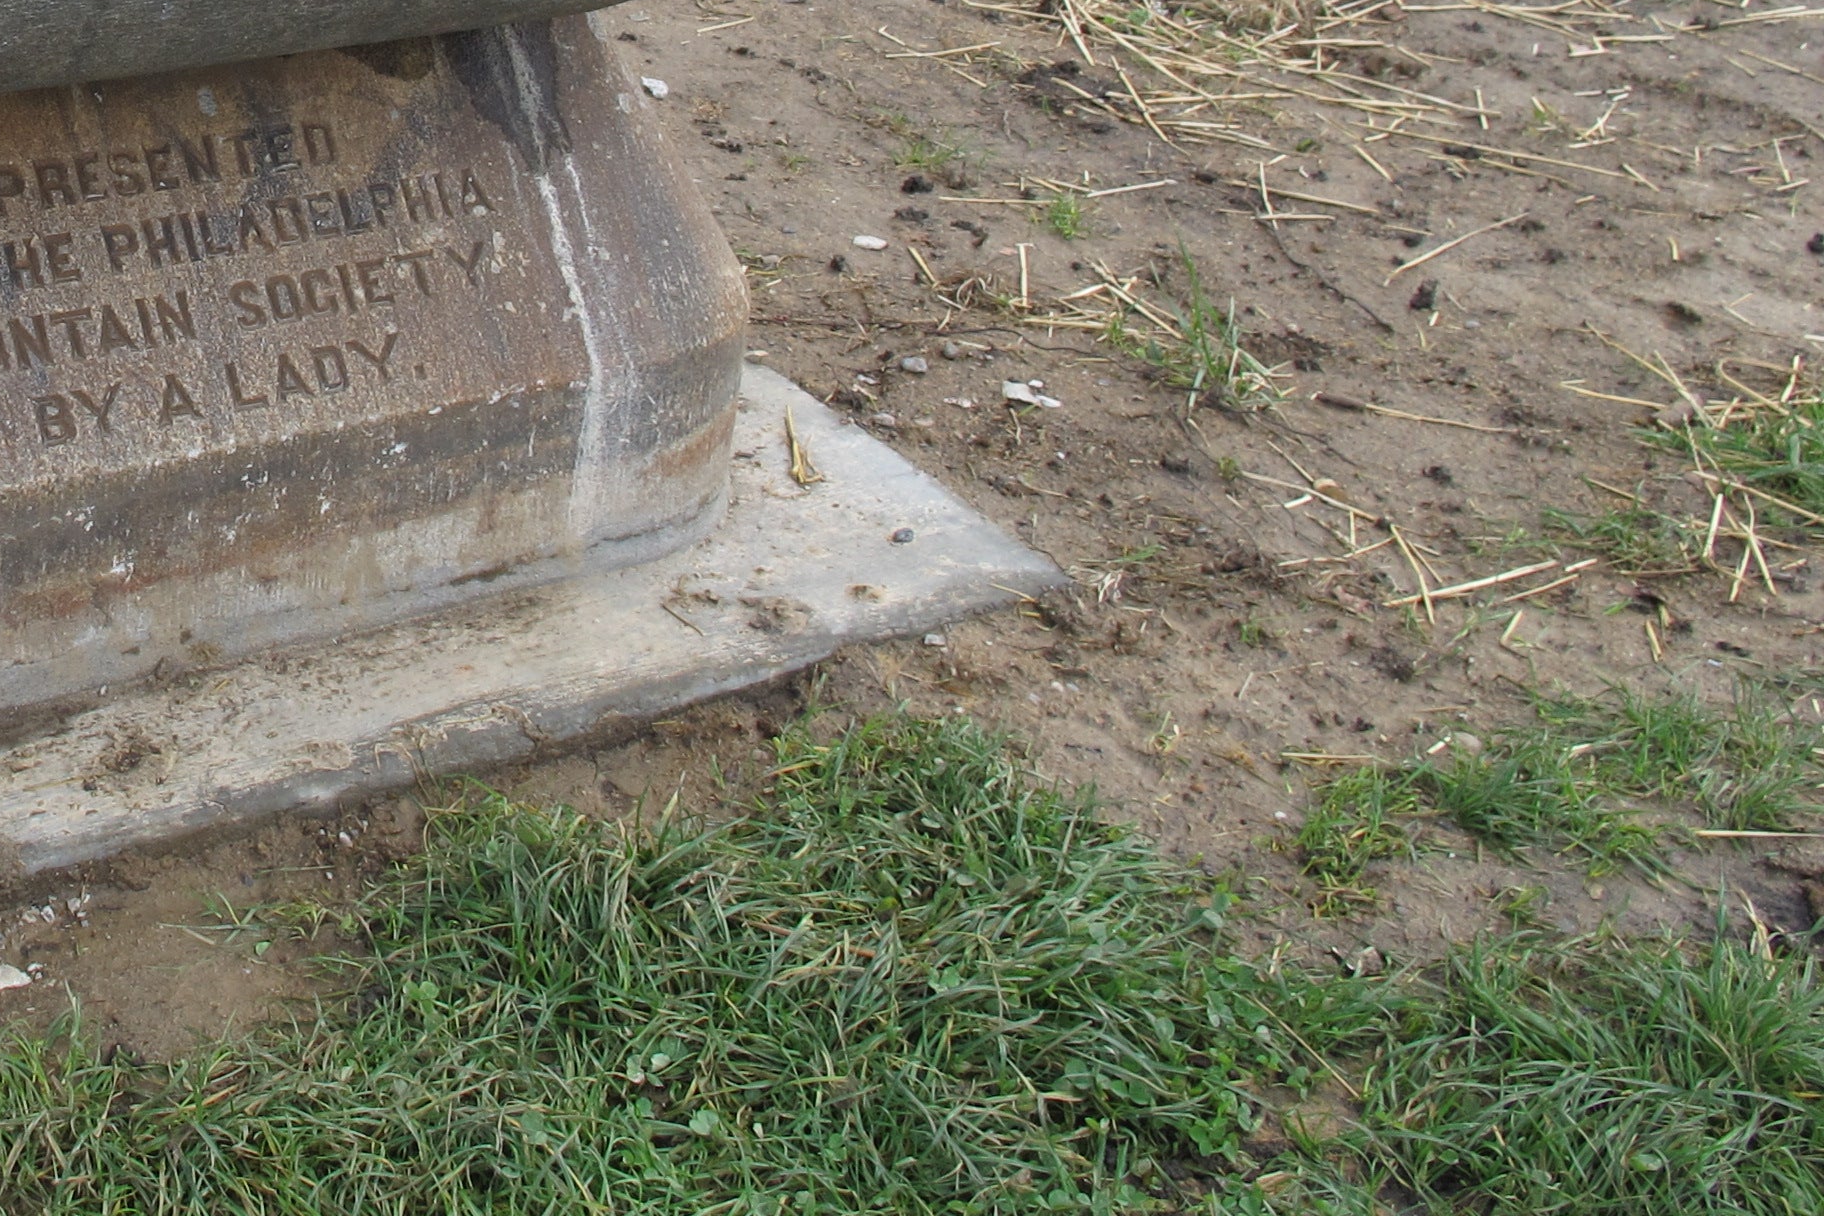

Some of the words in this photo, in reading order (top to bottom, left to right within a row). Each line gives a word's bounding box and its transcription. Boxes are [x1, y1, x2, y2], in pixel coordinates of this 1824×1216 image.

[101, 168, 497, 275] PHILADELPHIA
[228, 241, 484, 330] SOCIETY
[33, 381, 122, 447] BY
[159, 373, 206, 428] A
[226, 333, 426, 410] LADY.
